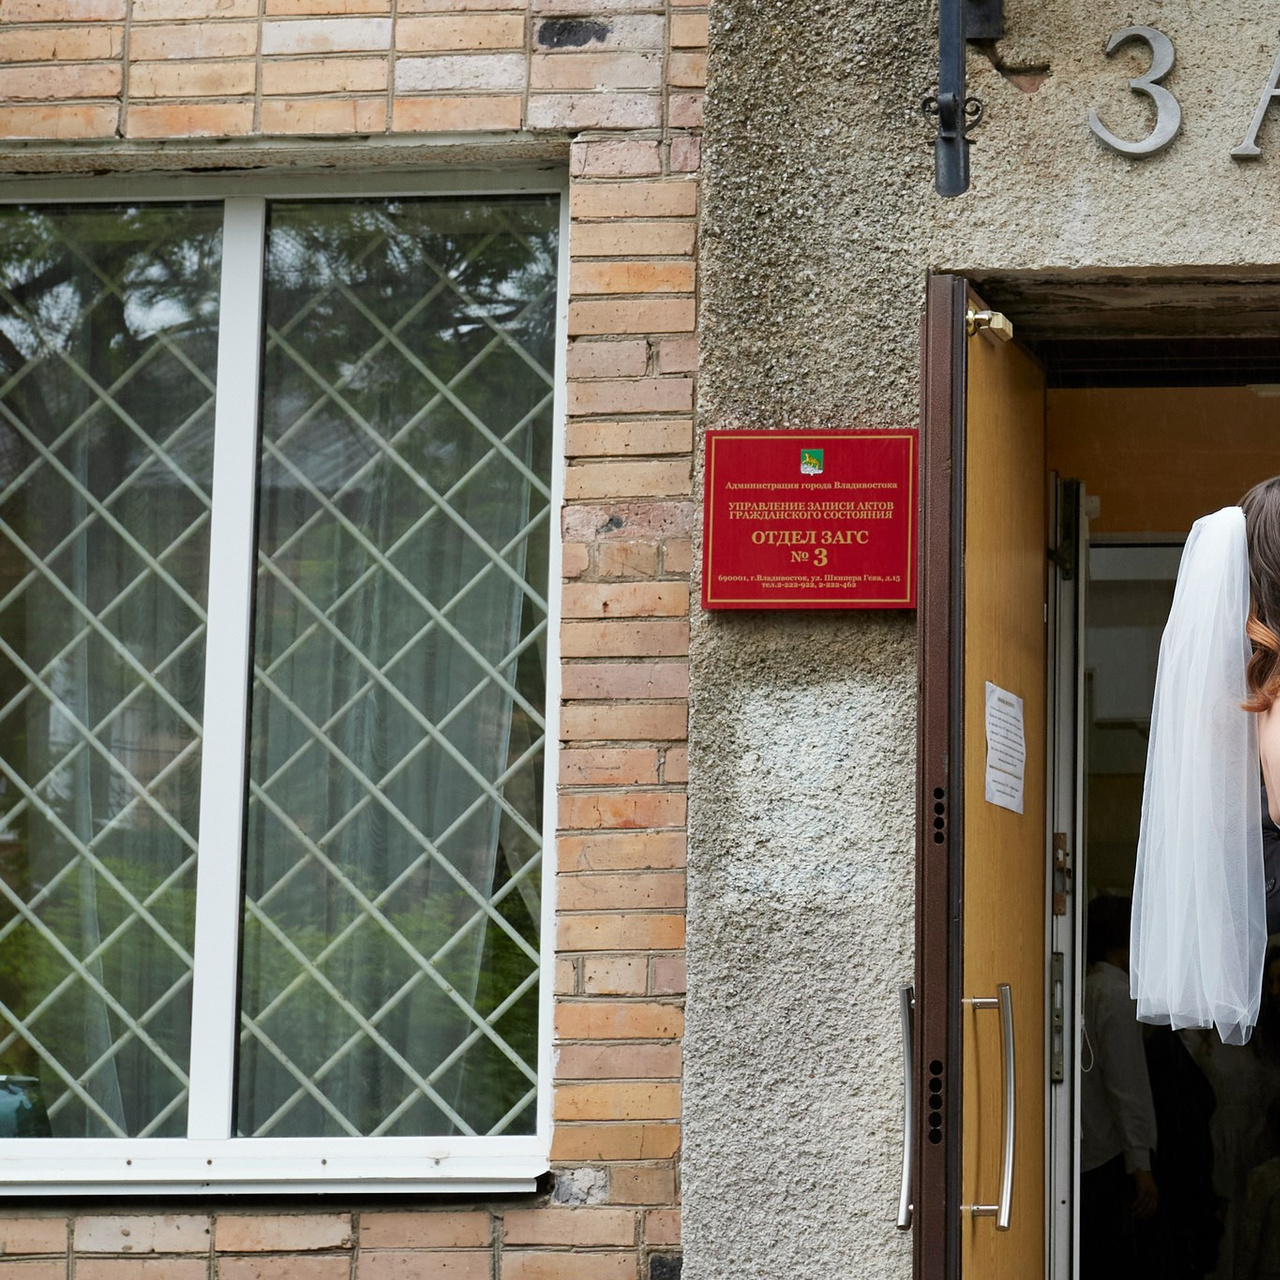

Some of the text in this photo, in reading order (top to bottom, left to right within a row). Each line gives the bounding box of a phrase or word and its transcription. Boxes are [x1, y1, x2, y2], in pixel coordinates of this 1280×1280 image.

[728, 502, 894, 510] УПРАВЛЕНИЕ ЗАПИСИ АКТОВ
[729, 511, 892, 520] ГРАЖДАНСКОГО СОСТОЯНИЯ
[751, 531, 869, 546] ОТДЕЛ ЗАГС
[791, 548, 828, 567] № 3
